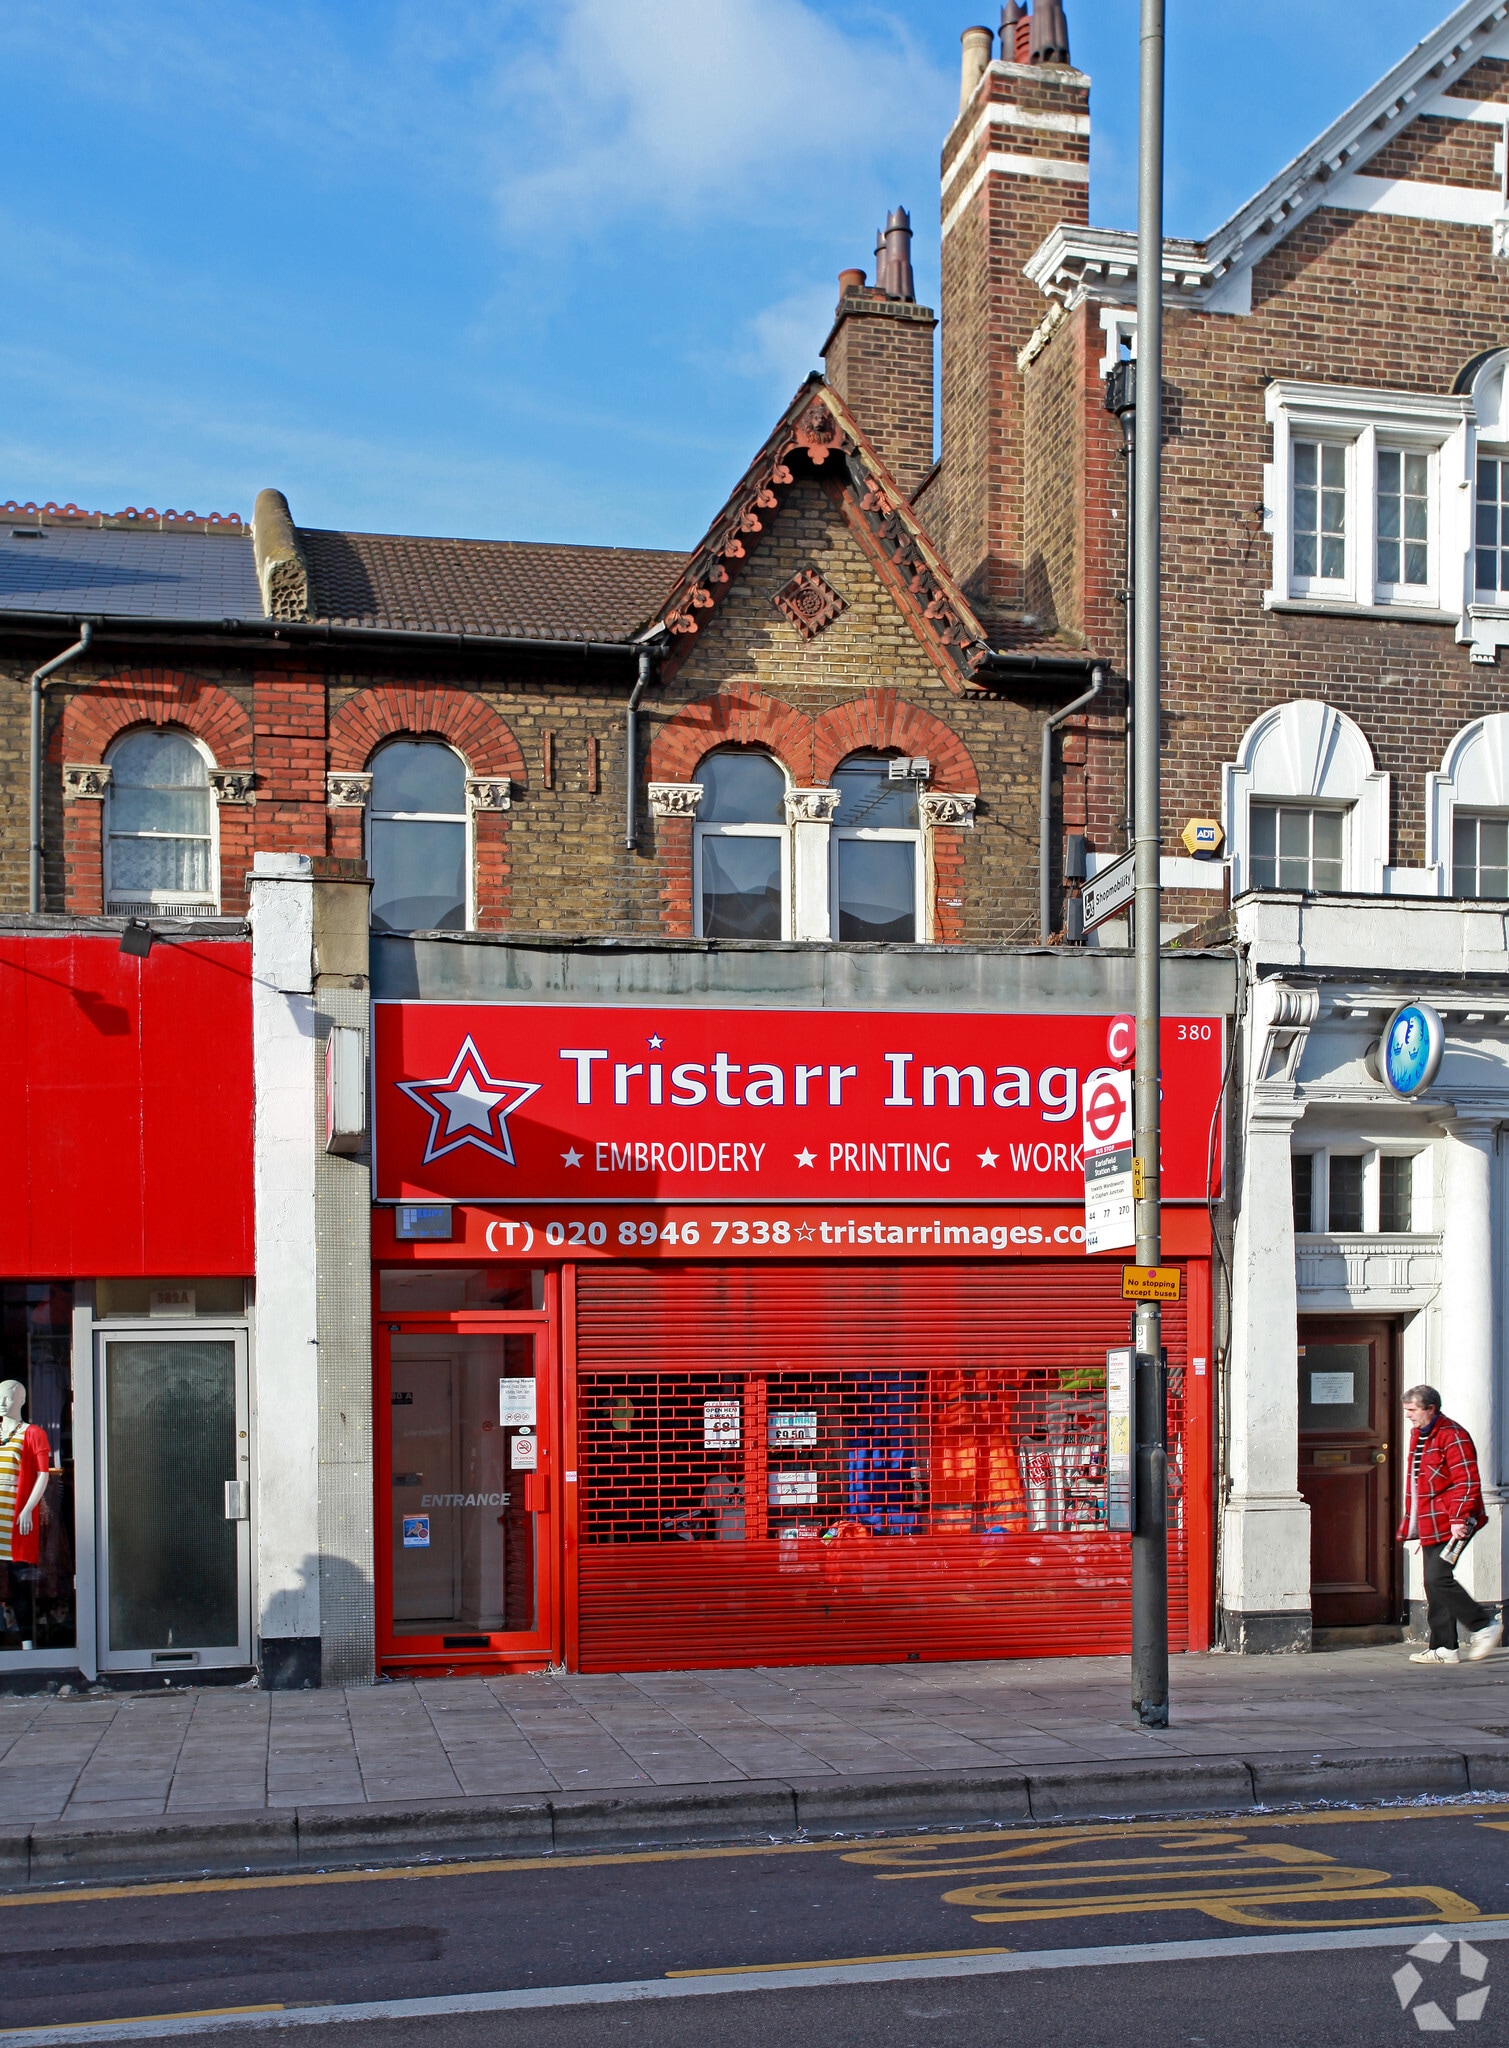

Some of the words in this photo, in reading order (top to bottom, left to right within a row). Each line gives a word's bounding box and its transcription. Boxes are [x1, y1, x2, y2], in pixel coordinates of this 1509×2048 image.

[1197, 828, 1214, 839] ADT
[1095, 873, 1131, 906] Shopmobility
[1109, 1022, 1129, 1058] C
[1177, 1025, 1211, 1041] 380
[559, 1033, 857, 1107] Tristarr
[883, 1052, 1164, 1122] Imag
[596, 1142, 766, 1172] EMBROIDERY
[829, 1142, 950, 1172] PRINTING
[1095, 1147, 1103, 1155] BUS
[1104, 1145, 1115, 1154] STOP
[1095, 1156, 1117, 1168] Earlsfield
[1094, 1168, 1111, 1177] Station
[1089, 1212, 1096, 1220] 44
[1103, 1209, 1111, 1218] 77
[1119, 1205, 1130, 1215] 270
[485, 1221, 534, 1252] (T)
[545, 1221, 607, 1246] 020
[617, 1221, 700, 1246] 8946
[710, 1221, 792, 1246] 7338
[820, 1219, 1087, 1250] tristarrimages.co
[1087, 1236, 1099, 1246] N44
[1142, 1280, 1176, 1289] stopping
[1154, 1289, 1177, 1298] buses
[776, 1430, 804, 1440] £950
[421, 1493, 512, 1507] ENTRANCE
